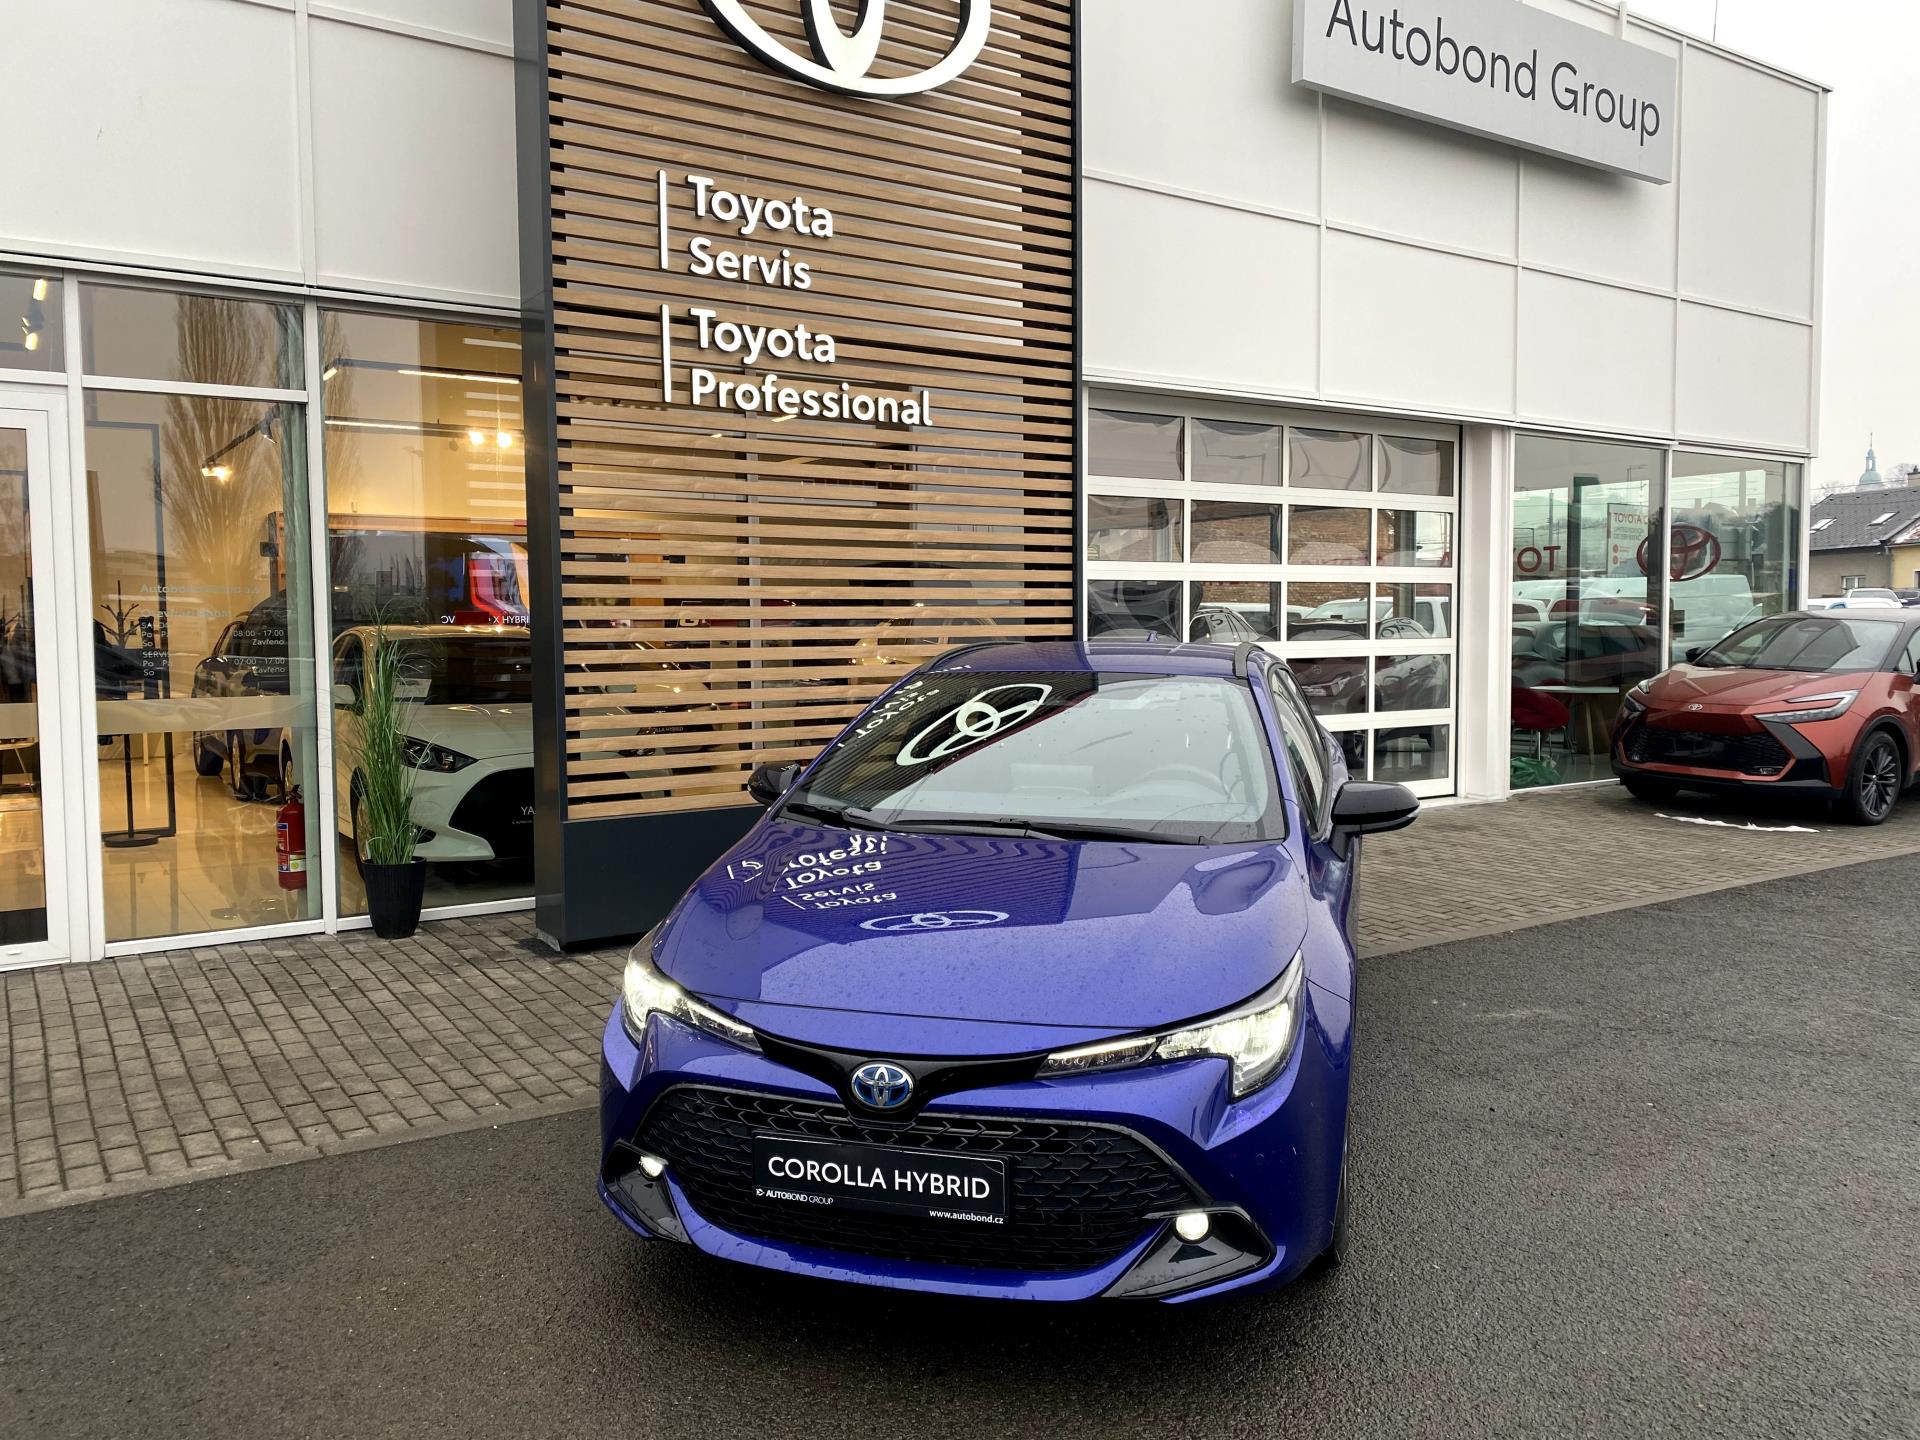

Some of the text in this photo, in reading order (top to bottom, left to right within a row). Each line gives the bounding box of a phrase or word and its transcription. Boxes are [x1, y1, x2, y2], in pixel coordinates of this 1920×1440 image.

[1325, 0, 1660, 146] Autobond Group
[687, 174, 834, 237] Toyota
[690, 236, 813, 289] Servis
[690, 307, 836, 364] Toyota
[692, 368, 933, 426] Professional
[502, 616, 529, 624] HYBRI
[766, 1188, 834, 1205] AUTOBOND GROUP
[768, 1156, 990, 1199] COROLLA HYBRID
[929, 1209, 1004, 1225] www.autobond.cz
